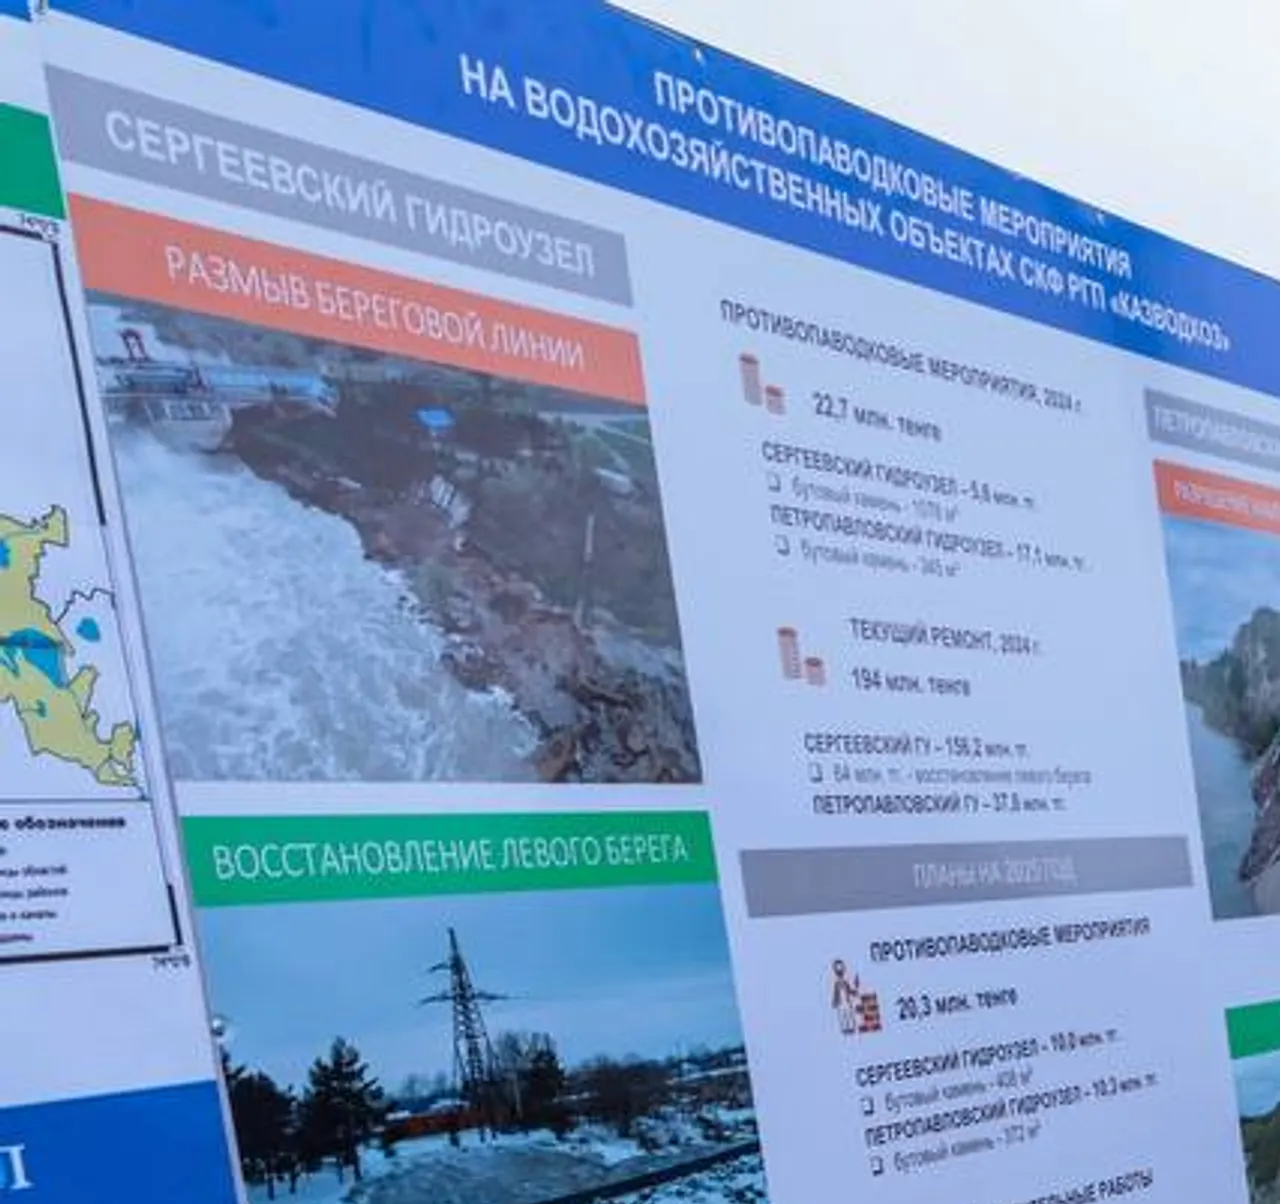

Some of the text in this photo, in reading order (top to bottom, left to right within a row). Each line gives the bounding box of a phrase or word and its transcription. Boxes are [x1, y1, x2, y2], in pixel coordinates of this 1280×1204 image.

[106, 110, 594, 279] СЕРГЕЕВСКИЙ ГИДРОУЗЕЛ
[655, 71, 1132, 279] ПРОТИВОПАВОДКОВЫЕ МЕРОПРИЯТИЯ
[459, 54, 1231, 351] НА ВОДОХОЗЯЙСТВЕННЫХ ОБЪЕКТАХ СКФ РГП «КАЗВОДХОЗ»
[166, 246, 584, 368] РАЗМЫВ БЕРЕГОВОЙ ЛИНИИ
[721, 299, 926, 375] ПРОТИВОПАВОДКОВЫЕ
[812, 391, 847, 421] 22,7
[762, 441, 872, 480] СЕРГЕЕВСКИЙ
[771, 503, 922, 545] ПЕТРОПАВЛОВСКИЙ
[850, 617, 928, 644] ТЕКУЩИЙ
[850, 668, 882, 691] 194
[804, 732, 913, 755] СЕРГЕЕВСКИЙ
[812, 791, 960, 815] ПЕТРОПАВЛОВСКИЙ
[213, 833, 689, 881] ВОССТАНОВЛЕНИЕ ЛЕВОГО БЕРЕГА
[913, 861, 975, 890] ПЛАНЫ
[870, 917, 1151, 963] ПРОТИВОПАВОДКОВЫЕ МЕРОПРИЯТИЯ
[896, 993, 932, 1021] 20,3
[855, 1050, 960, 1087] СЕРГЕЕВСКИЙ
[962, 1038, 1040, 1070] ГИДРОУЗЕЛ
[864, 1097, 1007, 1148] ПЕТРОПАВЛОВСКИЙ
[1008, 1084, 1082, 1119] ГИДРОУЗЕЛ
[1099, 1168, 1154, 1202] РАБОТЫ
